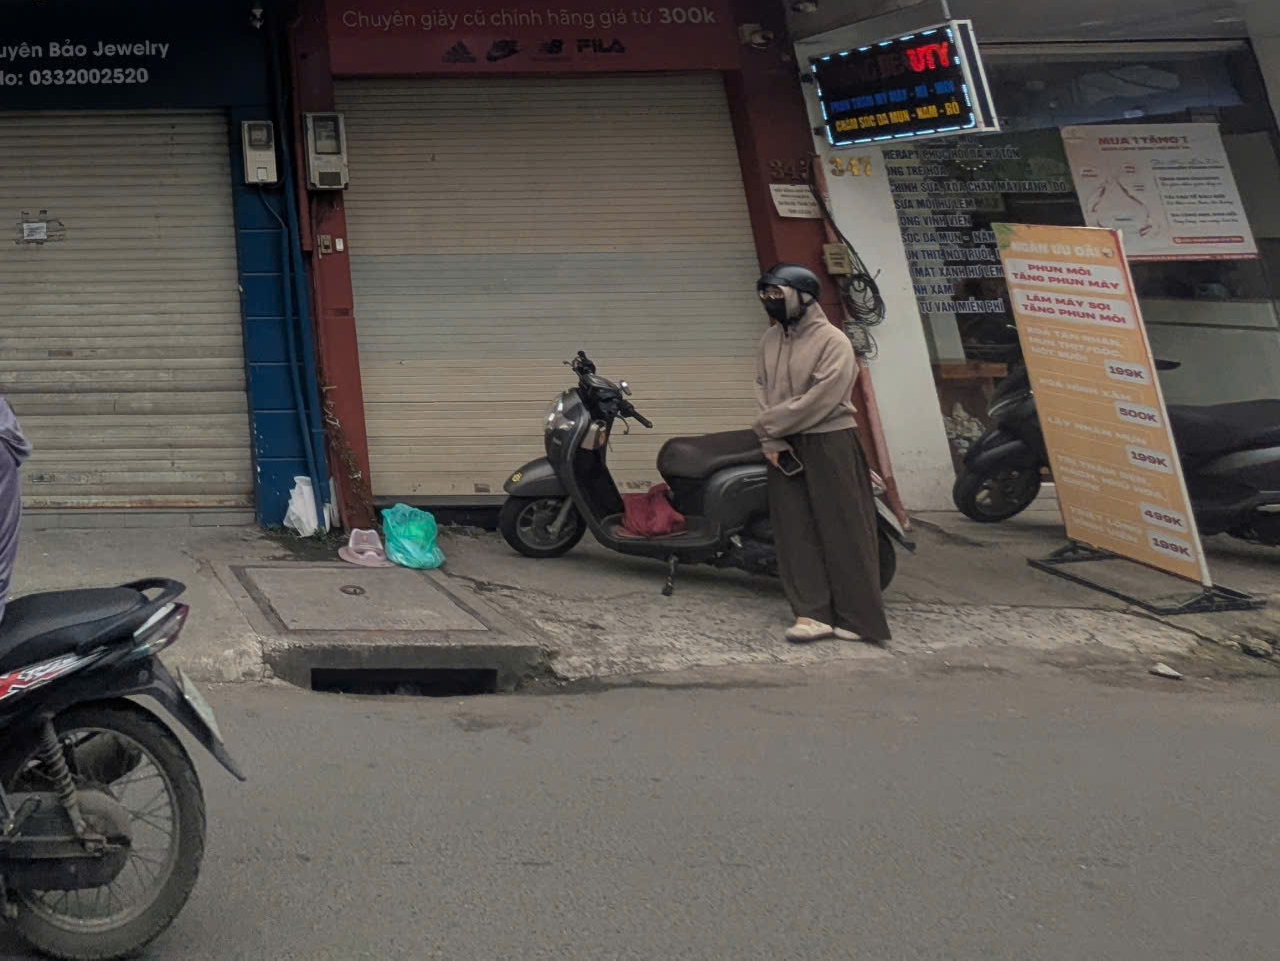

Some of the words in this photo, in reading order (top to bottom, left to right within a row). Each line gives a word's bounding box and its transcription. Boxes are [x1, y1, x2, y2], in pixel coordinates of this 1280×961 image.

[342, 9, 416, 31] Chuyên
[420, 9, 458, 31] giày
[463, 10, 487, 26] cũ
[490, 8, 543, 26] chính
[547, 8, 595, 29] hãng
[599, 8, 628, 29] giá
[631, 7, 653, 24] từ
[658, 6, 717, 24] 300k
[48, 39, 87, 59] Bảo
[92, 40, 170, 60] Jewelry
[28, 67, 150, 86] 0332002520
[828, 155, 873, 176] 347
[1027, 263, 1063, 275] PHUN
[1047, 275, 1085, 287] PHUN
[1058, 307, 1096, 320] PHUN
[1107, 365, 1145, 380] 199K
[1119, 406, 1159, 423] 500K
[1129, 449, 1169, 468] 199K
[1143, 508, 1183, 527] 499K
